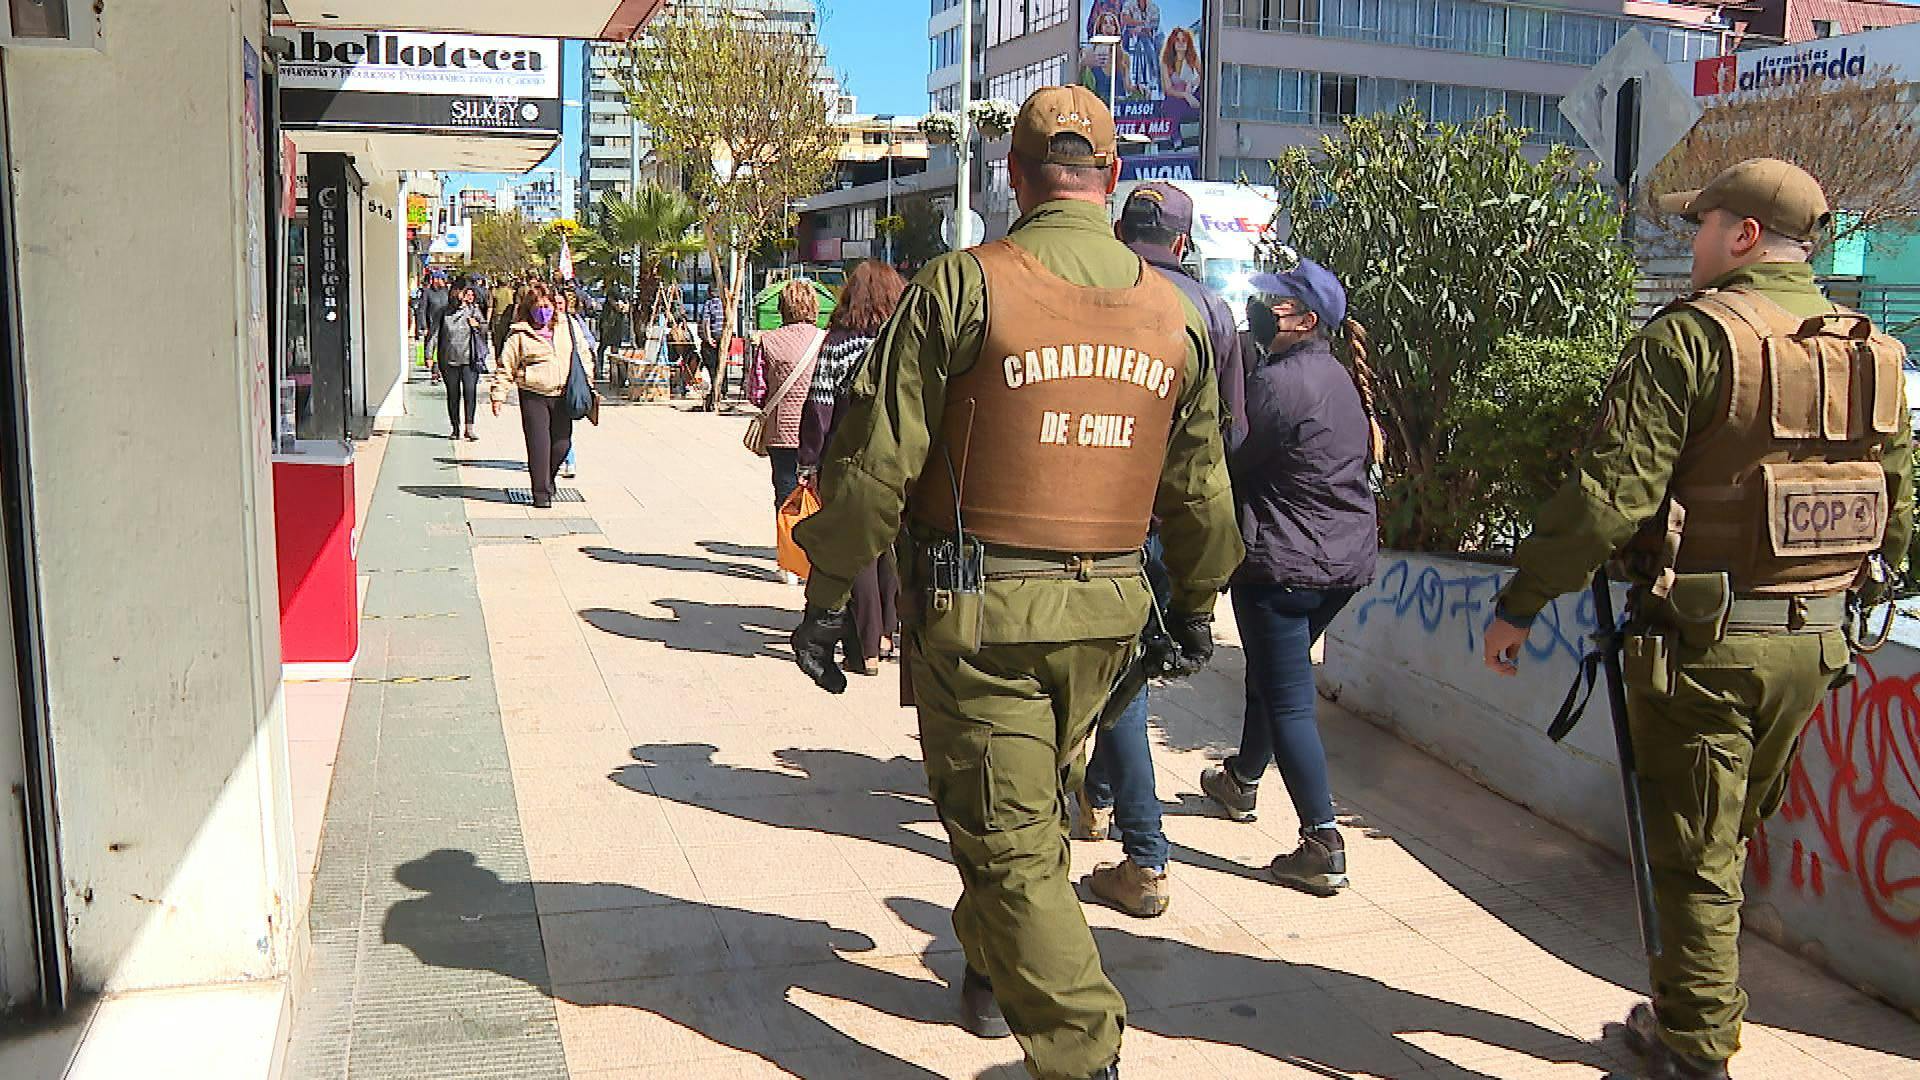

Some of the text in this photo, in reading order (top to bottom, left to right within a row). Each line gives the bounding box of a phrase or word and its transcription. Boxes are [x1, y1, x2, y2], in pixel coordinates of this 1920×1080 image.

[280, 31, 543, 72] abelloteca
[1762, 49, 1829, 68] farmacias
[1739, 47, 1865, 91] ahumada
[450, 102, 519, 119] SILKEY
[1138, 123, 1147, 133] A
[1135, 165, 1193, 180] WOM
[368, 200, 392, 221] 514
[1003, 344, 1176, 399] CARABINEROS
[1040, 410, 1136, 448] DE CHILE
[1792, 501, 1846, 533] COP
